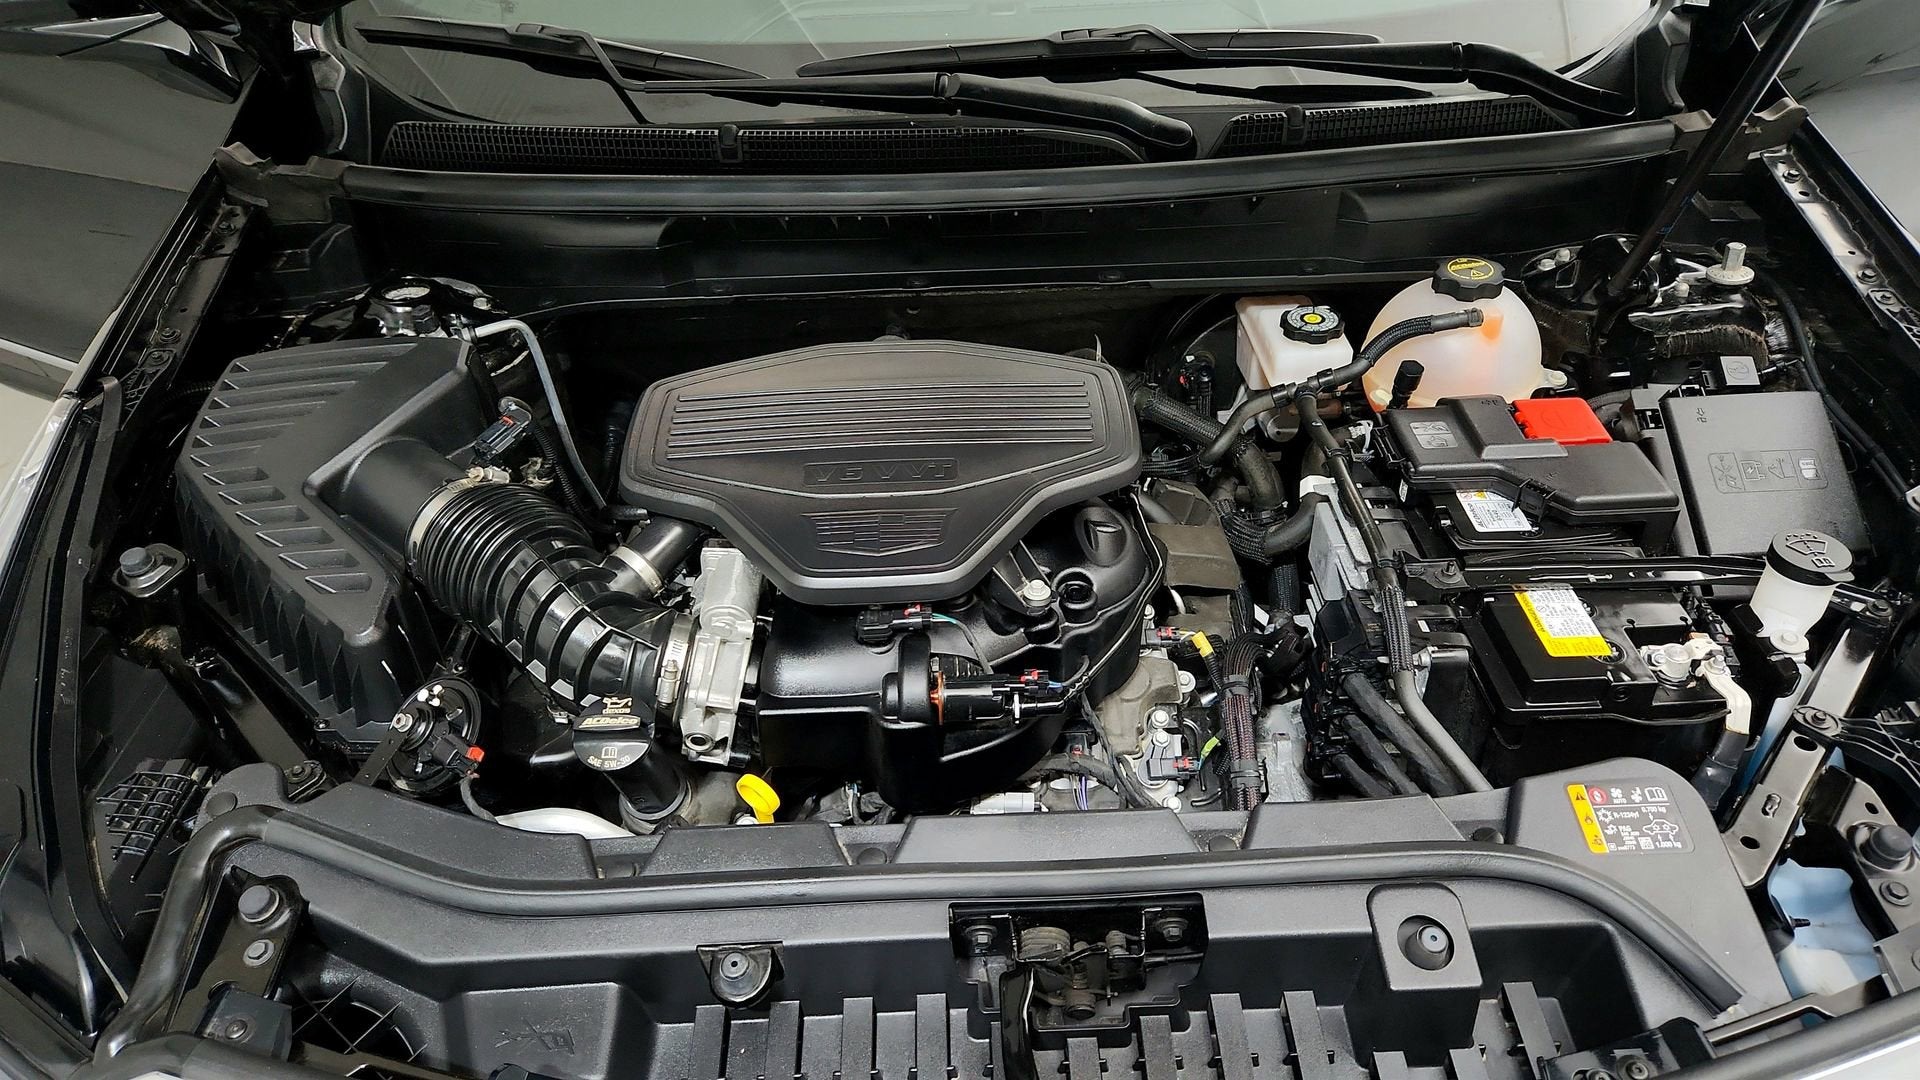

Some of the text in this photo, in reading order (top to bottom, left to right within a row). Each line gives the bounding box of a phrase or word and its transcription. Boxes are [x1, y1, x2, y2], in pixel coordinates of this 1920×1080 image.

[808, 466, 864, 482] V6
[582, 717, 639, 725] ACDelco
[587, 755, 631, 768] SAE 5W-30
